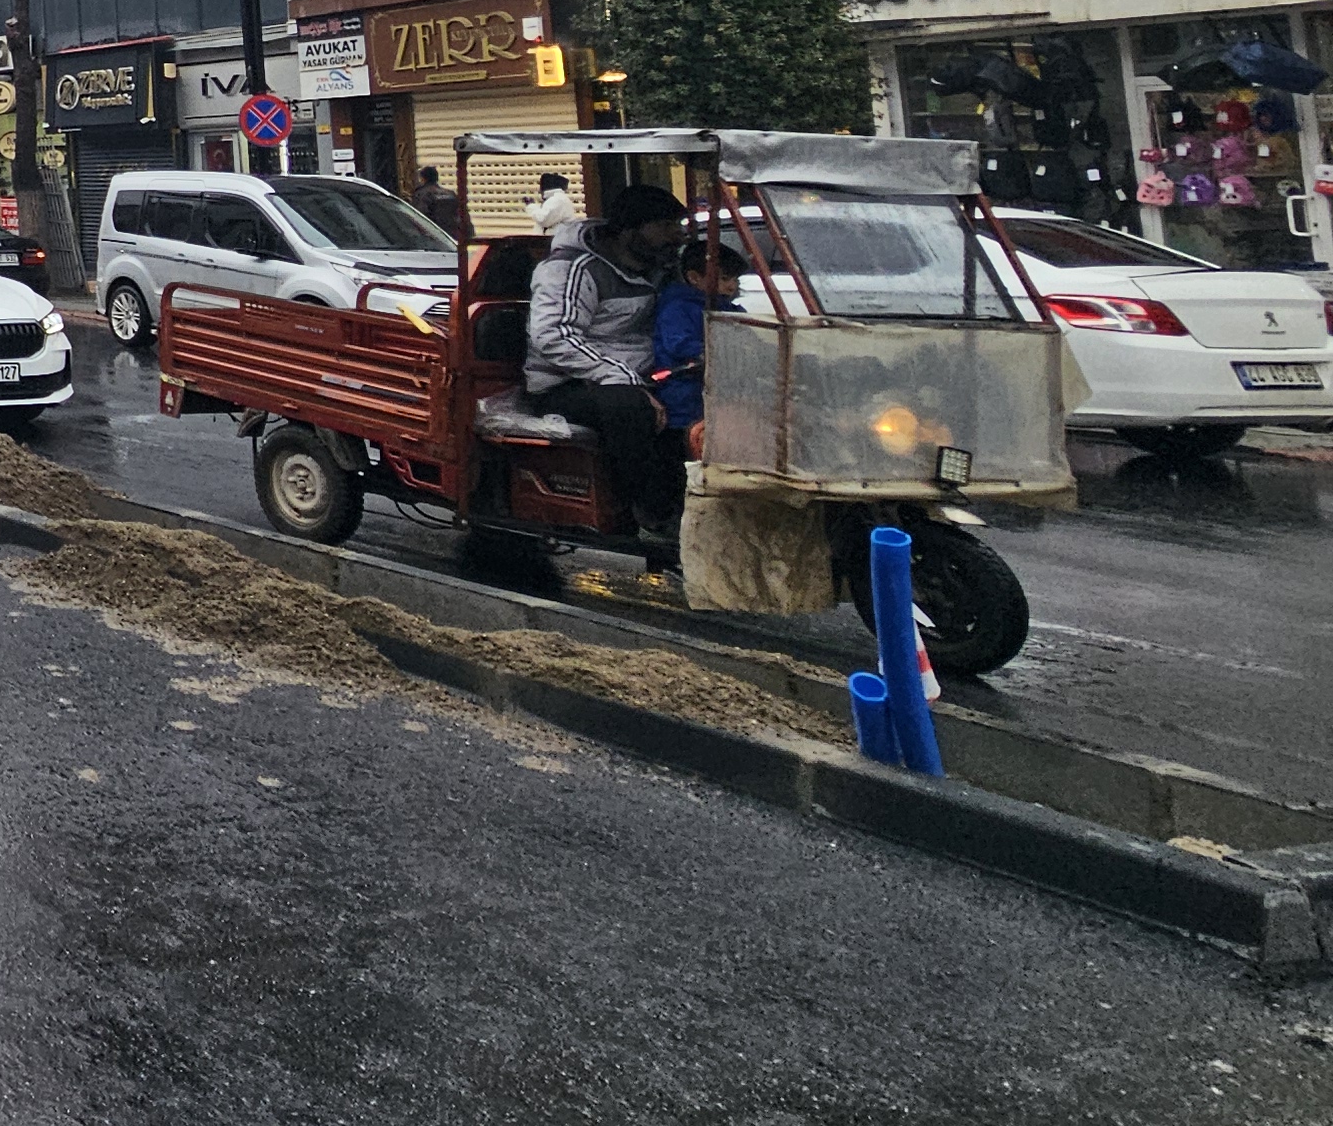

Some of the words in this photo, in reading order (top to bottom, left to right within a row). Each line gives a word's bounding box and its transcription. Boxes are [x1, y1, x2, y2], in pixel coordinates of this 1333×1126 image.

[305, 38, 359, 57] AVUKAT
[316, 82, 354, 93] ALYANS
[0, 366, 18, 380] 127
